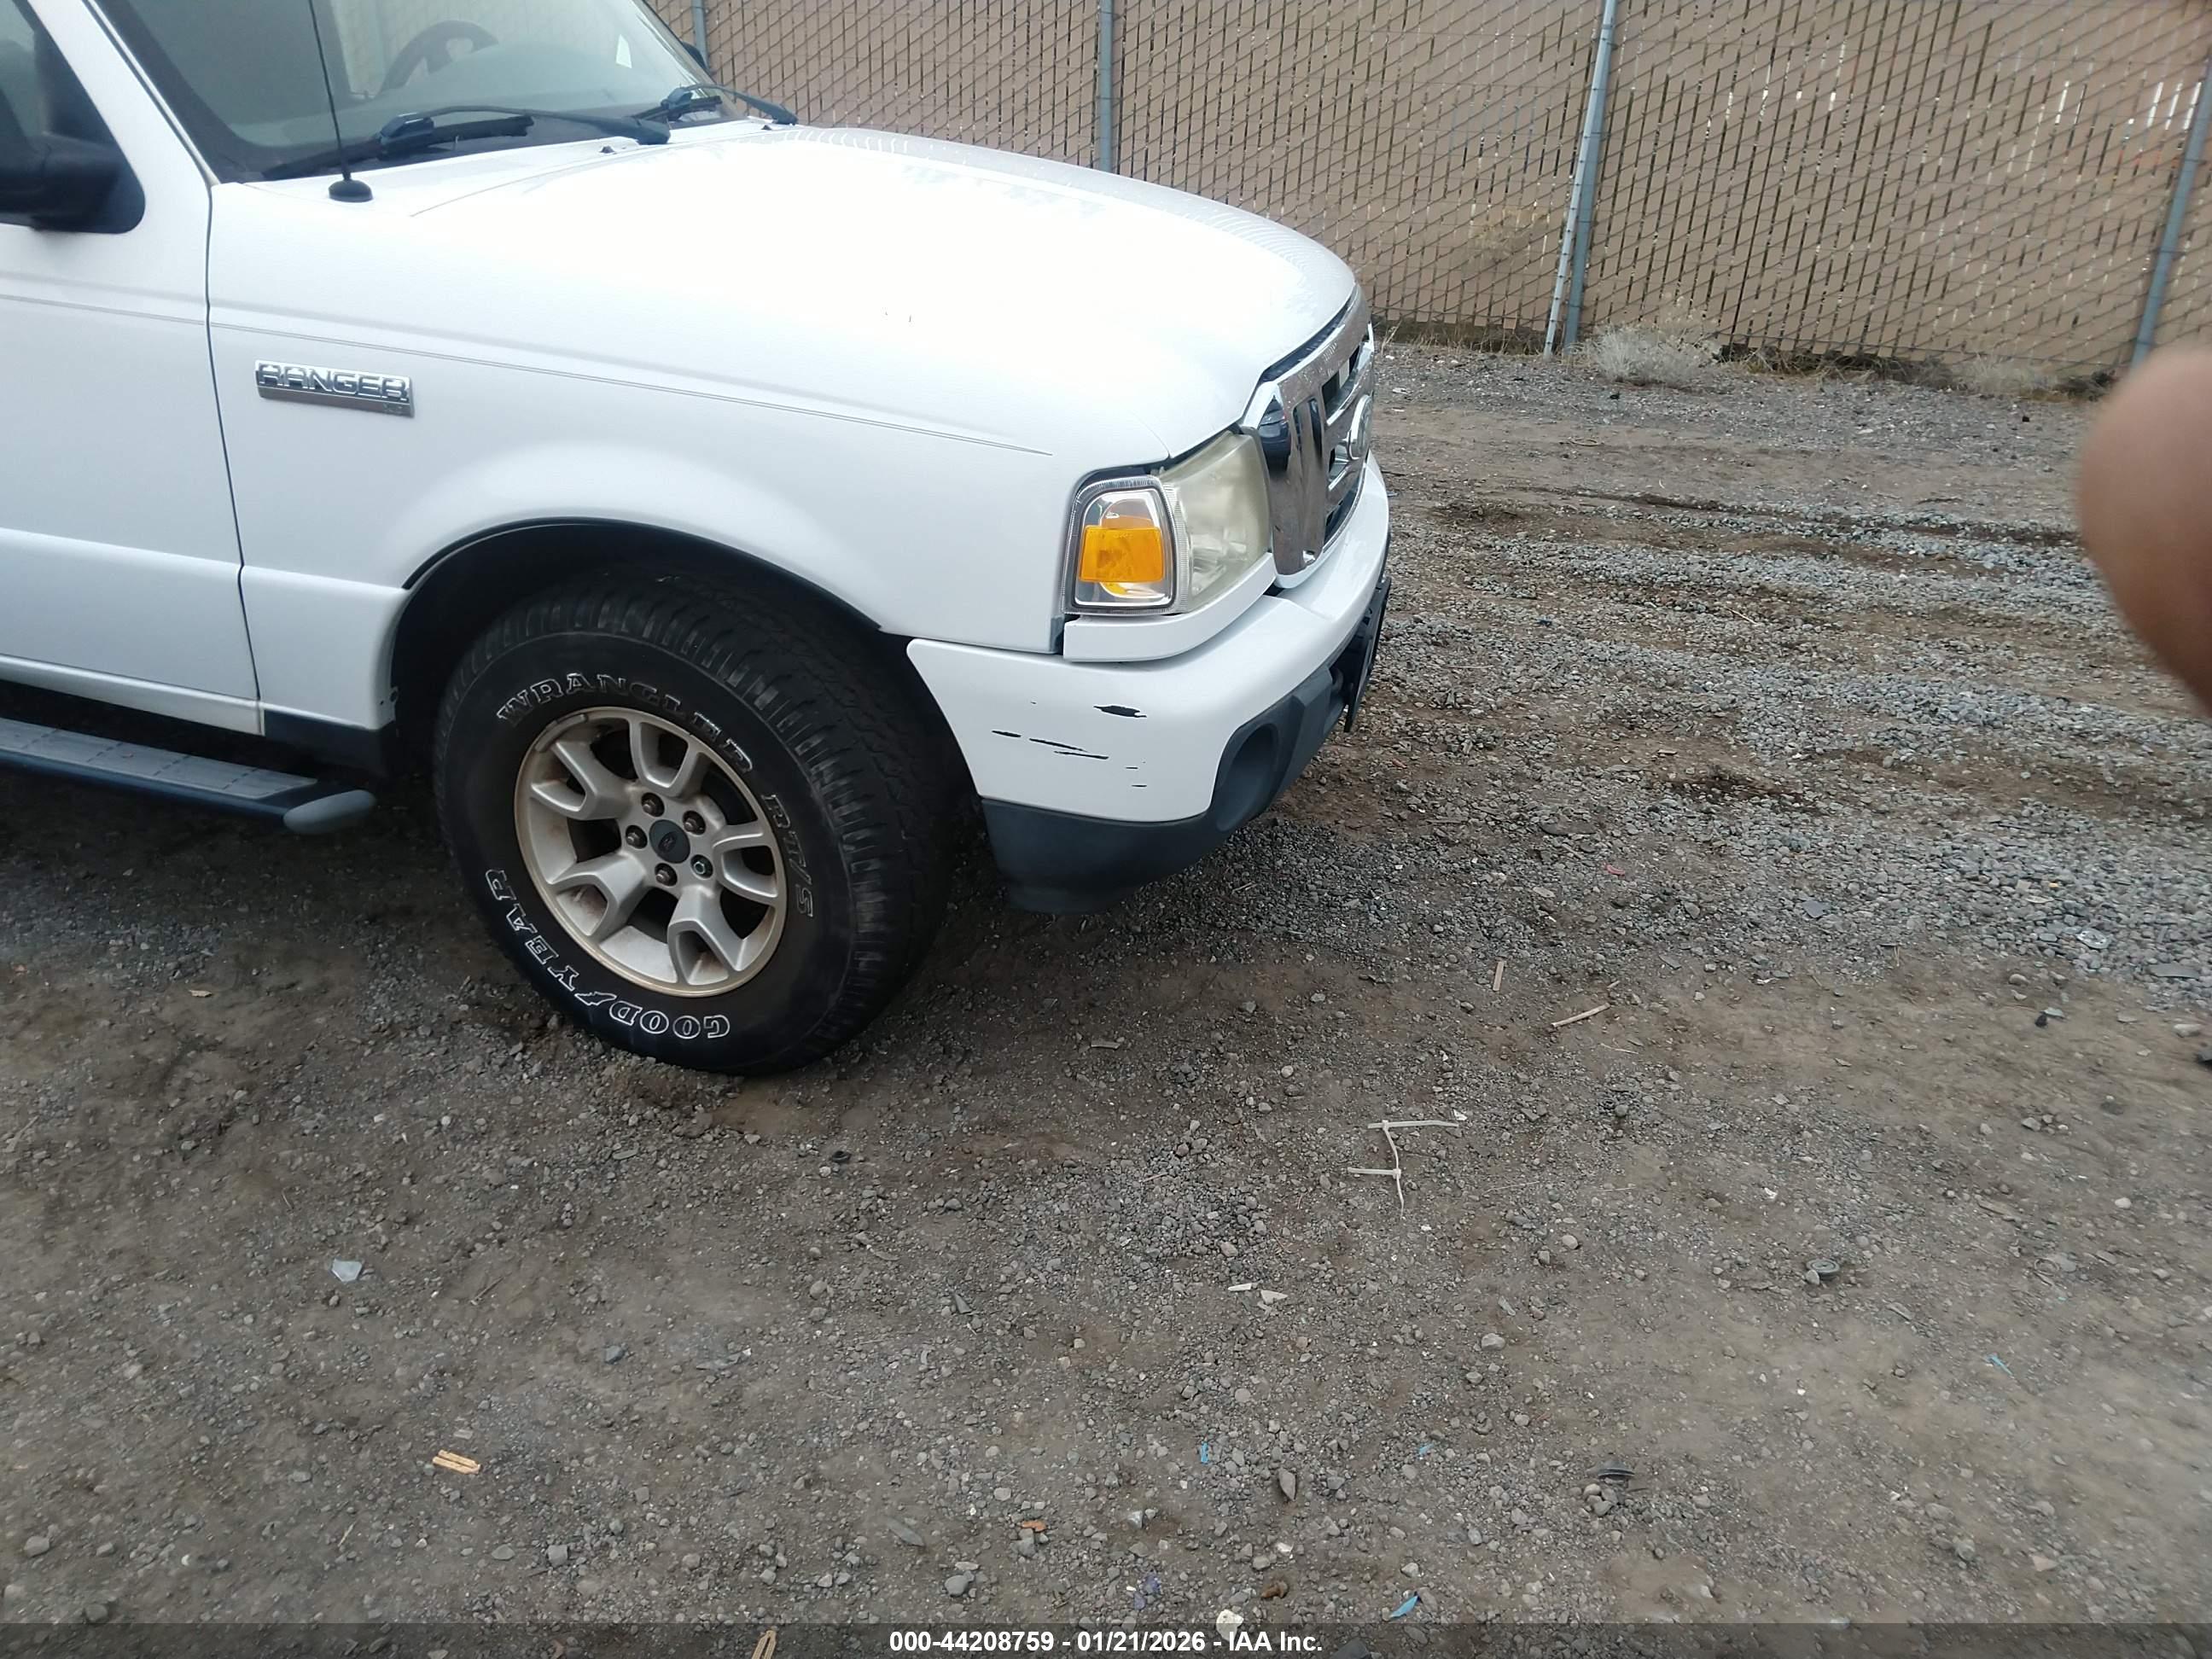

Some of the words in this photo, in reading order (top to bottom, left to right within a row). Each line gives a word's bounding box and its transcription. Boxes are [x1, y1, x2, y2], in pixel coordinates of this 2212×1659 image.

[258, 363, 408, 402] RANGER
[497, 672, 753, 774] WRANGLER
[762, 793, 814, 918] RT/S
[485, 869, 731, 1039] GOODYEAR
